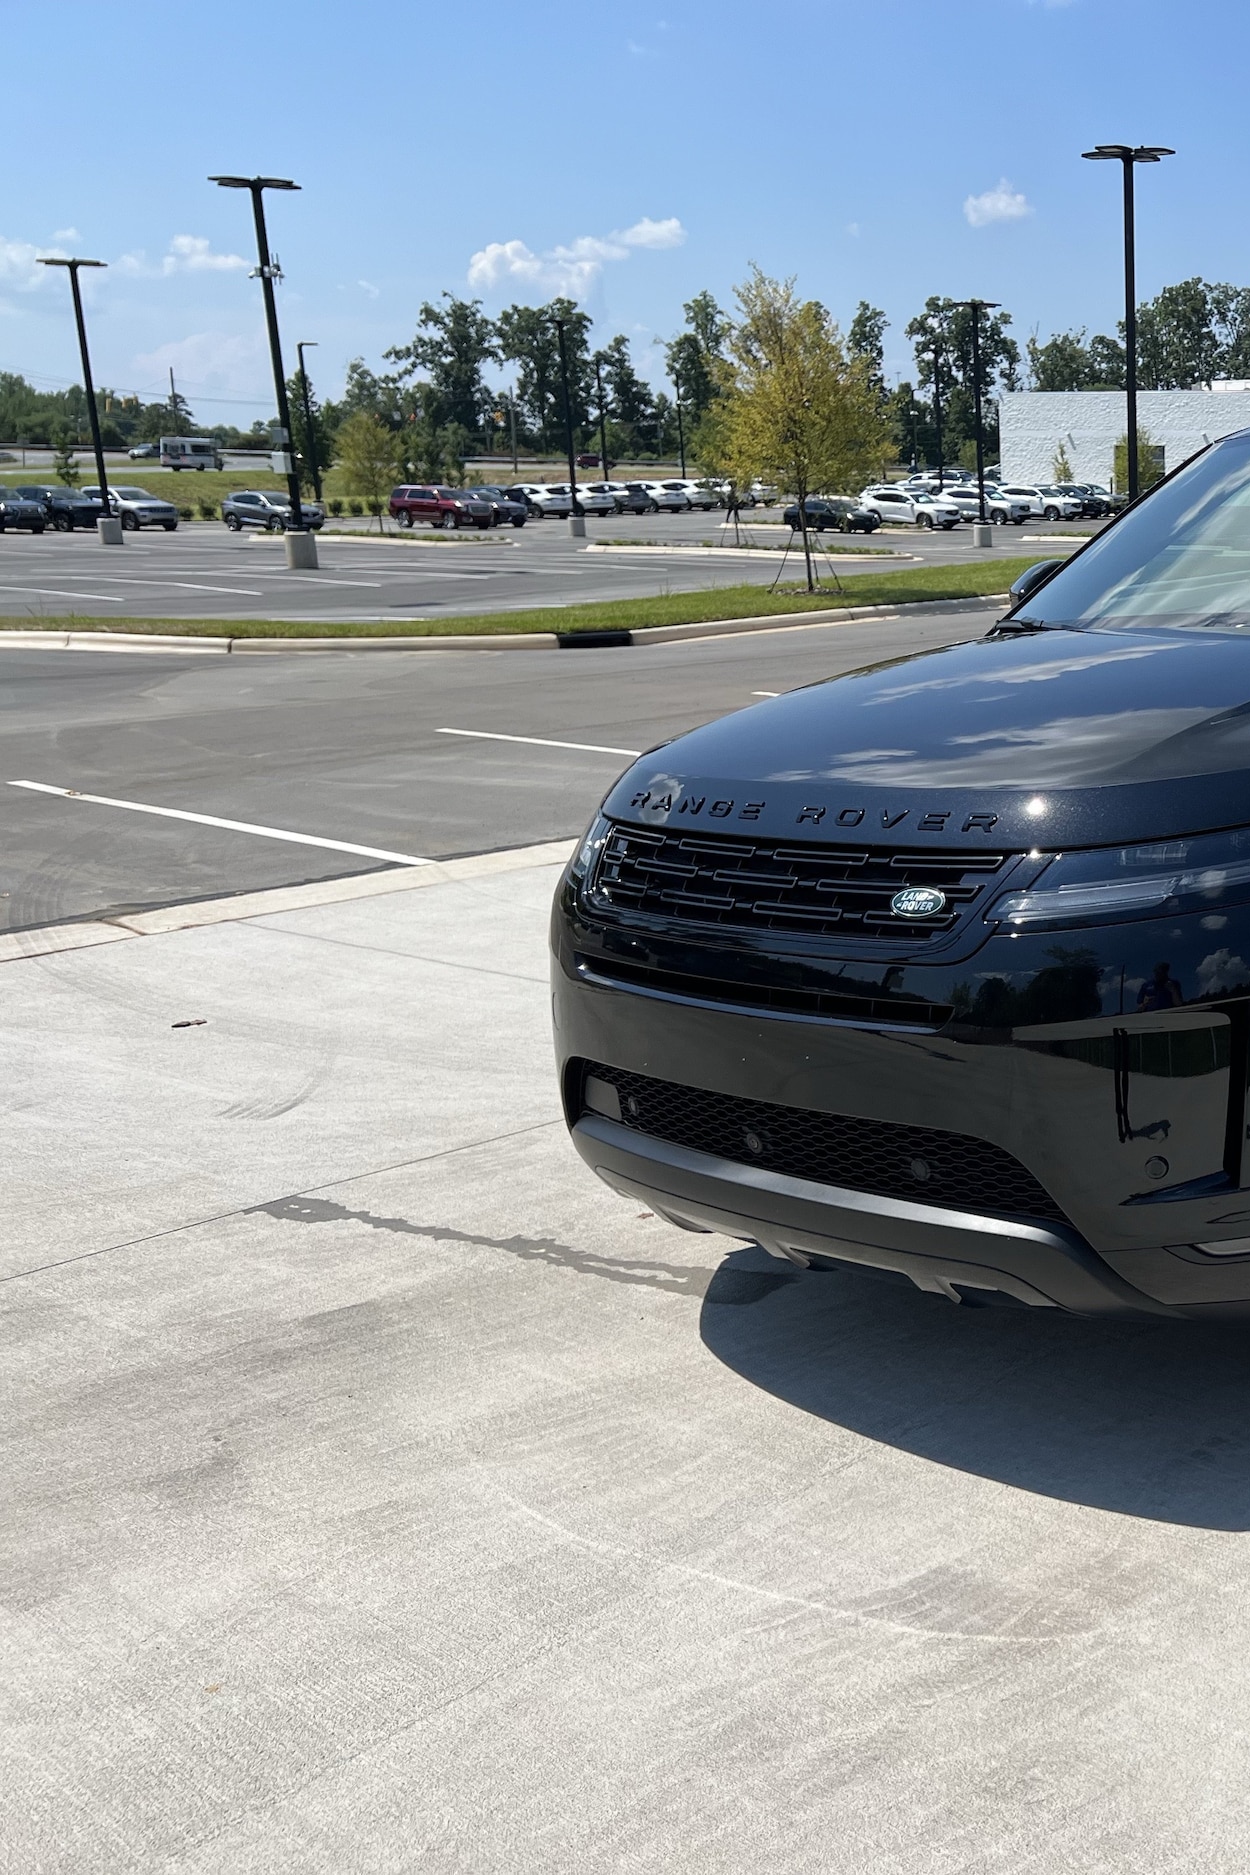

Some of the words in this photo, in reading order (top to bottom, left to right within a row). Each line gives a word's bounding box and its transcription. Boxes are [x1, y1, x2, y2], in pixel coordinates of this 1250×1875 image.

[630, 791, 766, 820] RANGE
[796, 806, 999, 833] ROVER
[901, 892, 929, 901] LAND
[900, 901, 934, 911] ROVER
